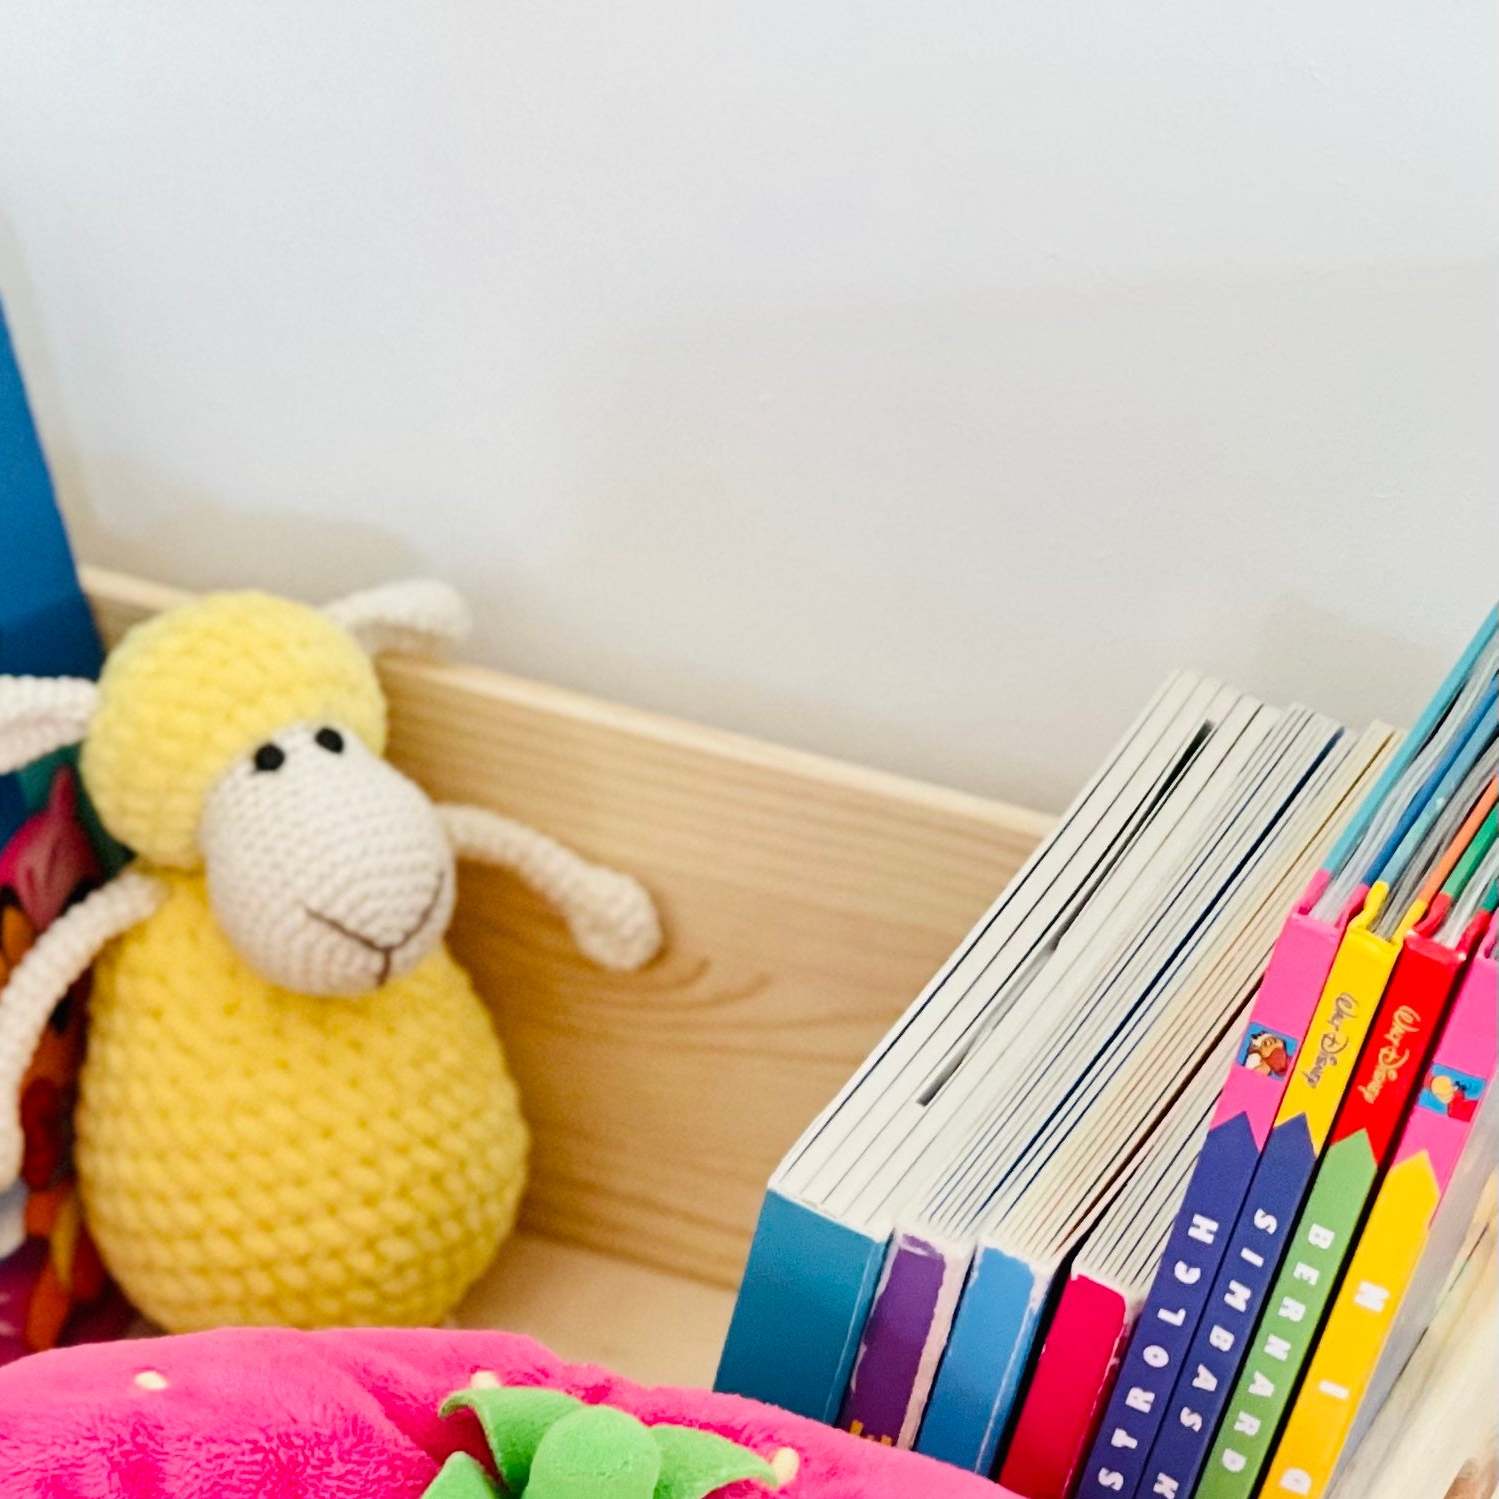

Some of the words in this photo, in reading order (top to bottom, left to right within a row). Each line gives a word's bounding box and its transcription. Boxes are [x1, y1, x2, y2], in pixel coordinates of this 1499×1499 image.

[1098, 1213, 1219, 1491] STROLCH
[1180, 1208, 1277, 1432] SIMBAS
[1222, 1223, 1335, 1473] BERNARD
